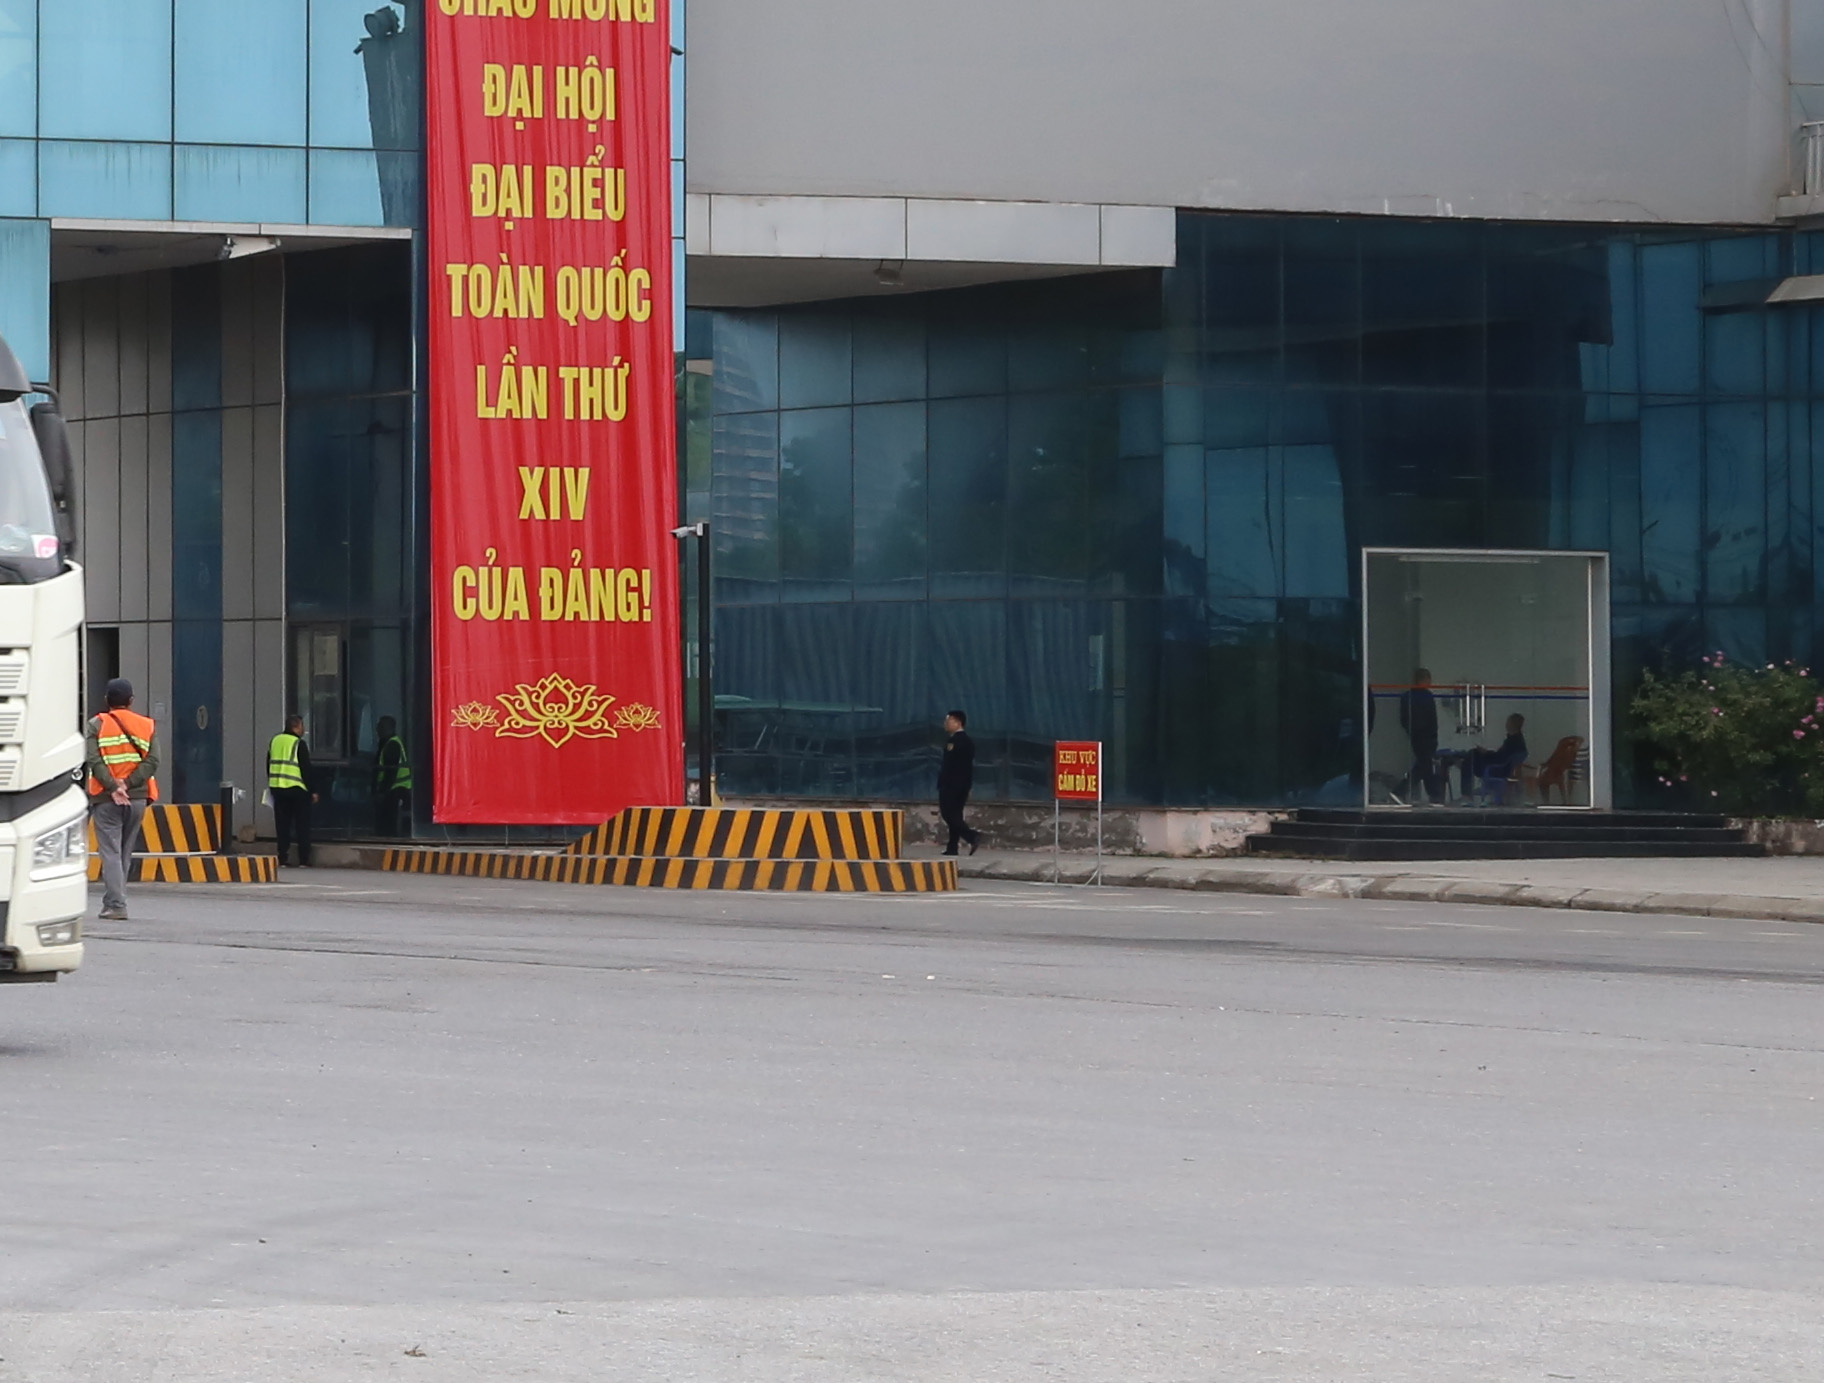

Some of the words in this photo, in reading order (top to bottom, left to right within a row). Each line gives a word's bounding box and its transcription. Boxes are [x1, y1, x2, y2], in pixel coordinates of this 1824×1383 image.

[482, 63, 543, 130] ĐẠI
[557, 56, 615, 132] HỘI
[471, 163, 533, 230] ĐẠI
[545, 145, 626, 222] BIỂU
[446, 253, 544, 319] TOÀN
[557, 248, 652, 326] QUỐC
[476, 347, 548, 420] LẦN
[559, 358, 630, 422] THỨ
[519, 466, 591, 521] XIV
[452, 547, 530, 621] CỦA
[539, 548, 653, 623] ĐẢNG!
[1058, 750, 1077, 764] KHU
[1079, 749, 1097, 767] VỰC
[1086, 774, 1097, 792] XE
